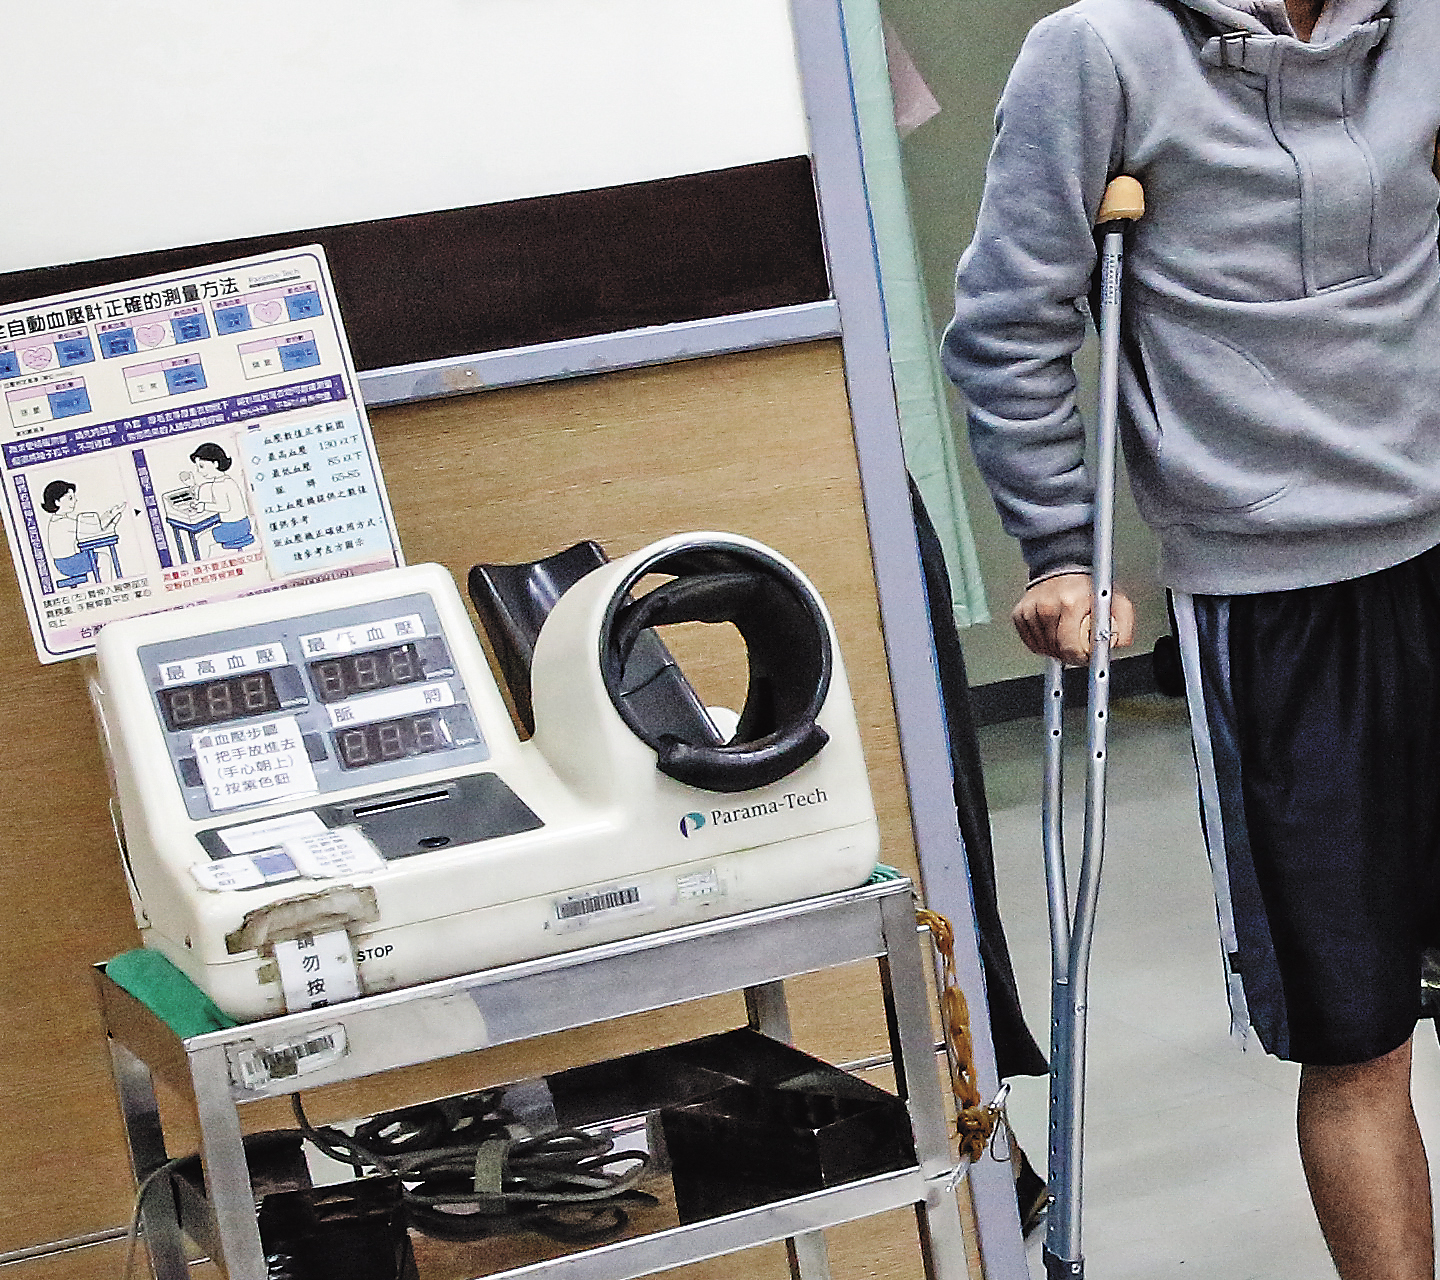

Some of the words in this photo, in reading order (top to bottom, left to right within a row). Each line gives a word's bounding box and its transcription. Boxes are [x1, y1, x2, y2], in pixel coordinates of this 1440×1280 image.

[165, 647, 276, 681] 最高血壓
[711, 787, 828, 826] Parama-Tech
[357, 945, 394, 962] STOP
